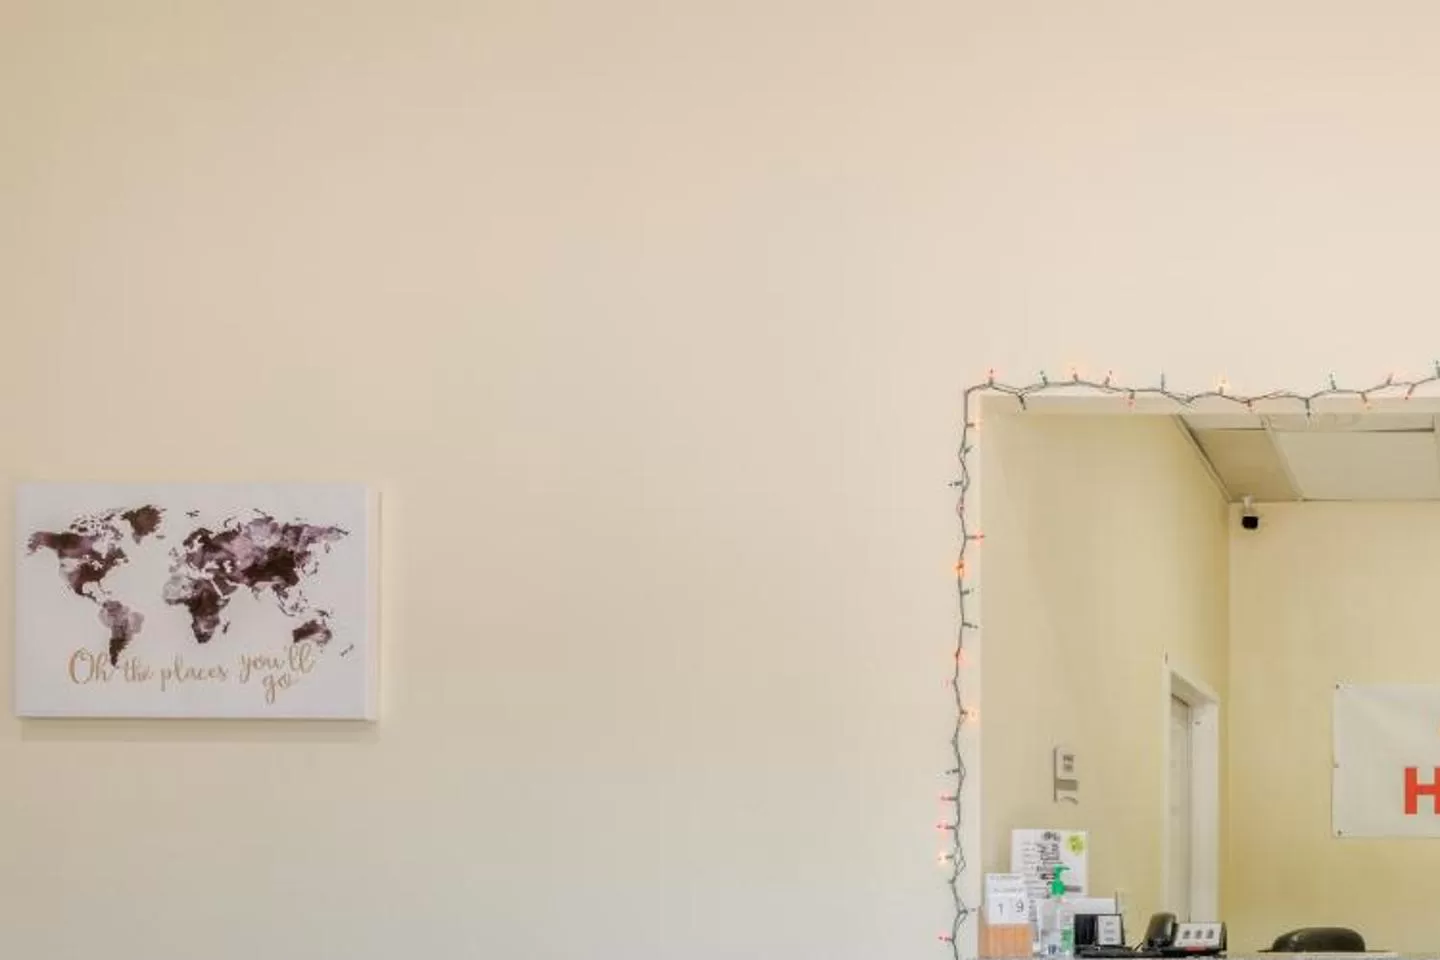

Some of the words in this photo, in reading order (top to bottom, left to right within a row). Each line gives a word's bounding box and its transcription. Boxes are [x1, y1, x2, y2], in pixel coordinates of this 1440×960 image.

[68, 647, 112, 684] Oh
[160, 654, 229, 692] places
[262, 671, 298, 704] go
